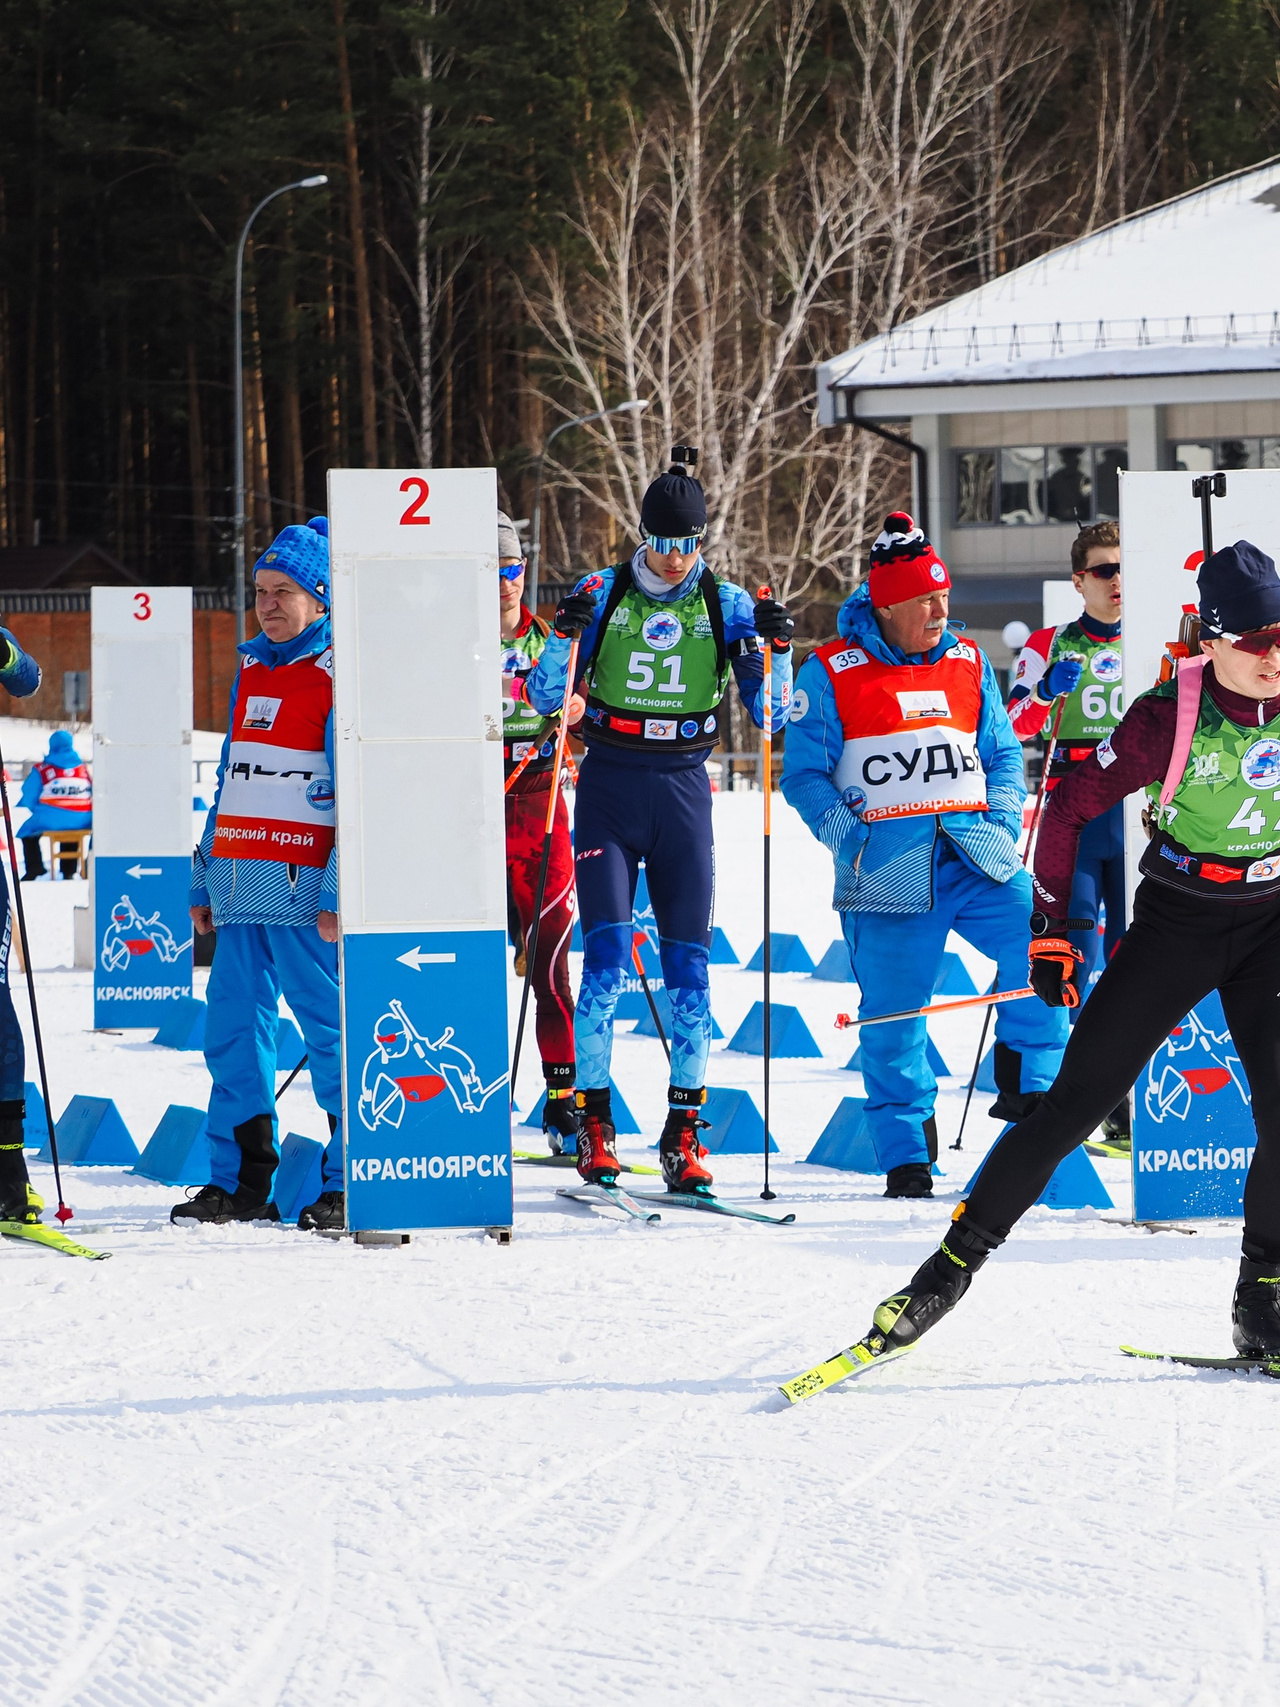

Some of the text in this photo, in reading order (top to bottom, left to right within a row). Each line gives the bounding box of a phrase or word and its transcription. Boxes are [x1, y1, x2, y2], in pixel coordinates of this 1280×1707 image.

[400, 477, 431, 525] 2
[133, 593, 152, 620] 3
[836, 650, 860, 668] 35
[626, 651, 687, 693] 51
[625, 696, 683, 708] КРАСНОЯРСК
[214, 826, 314, 847] оярский край
[97, 985, 190, 1001] КРАСНОЯРСК
[553, 1067, 570, 1075] 205
[673, 1090, 688, 1100] 201
[352, 1154, 508, 1181] КРАСНОЯРСК
[1139, 1147, 1255, 1172] КРАСНОЯ
[941, 1242, 968, 1269] SCHER
